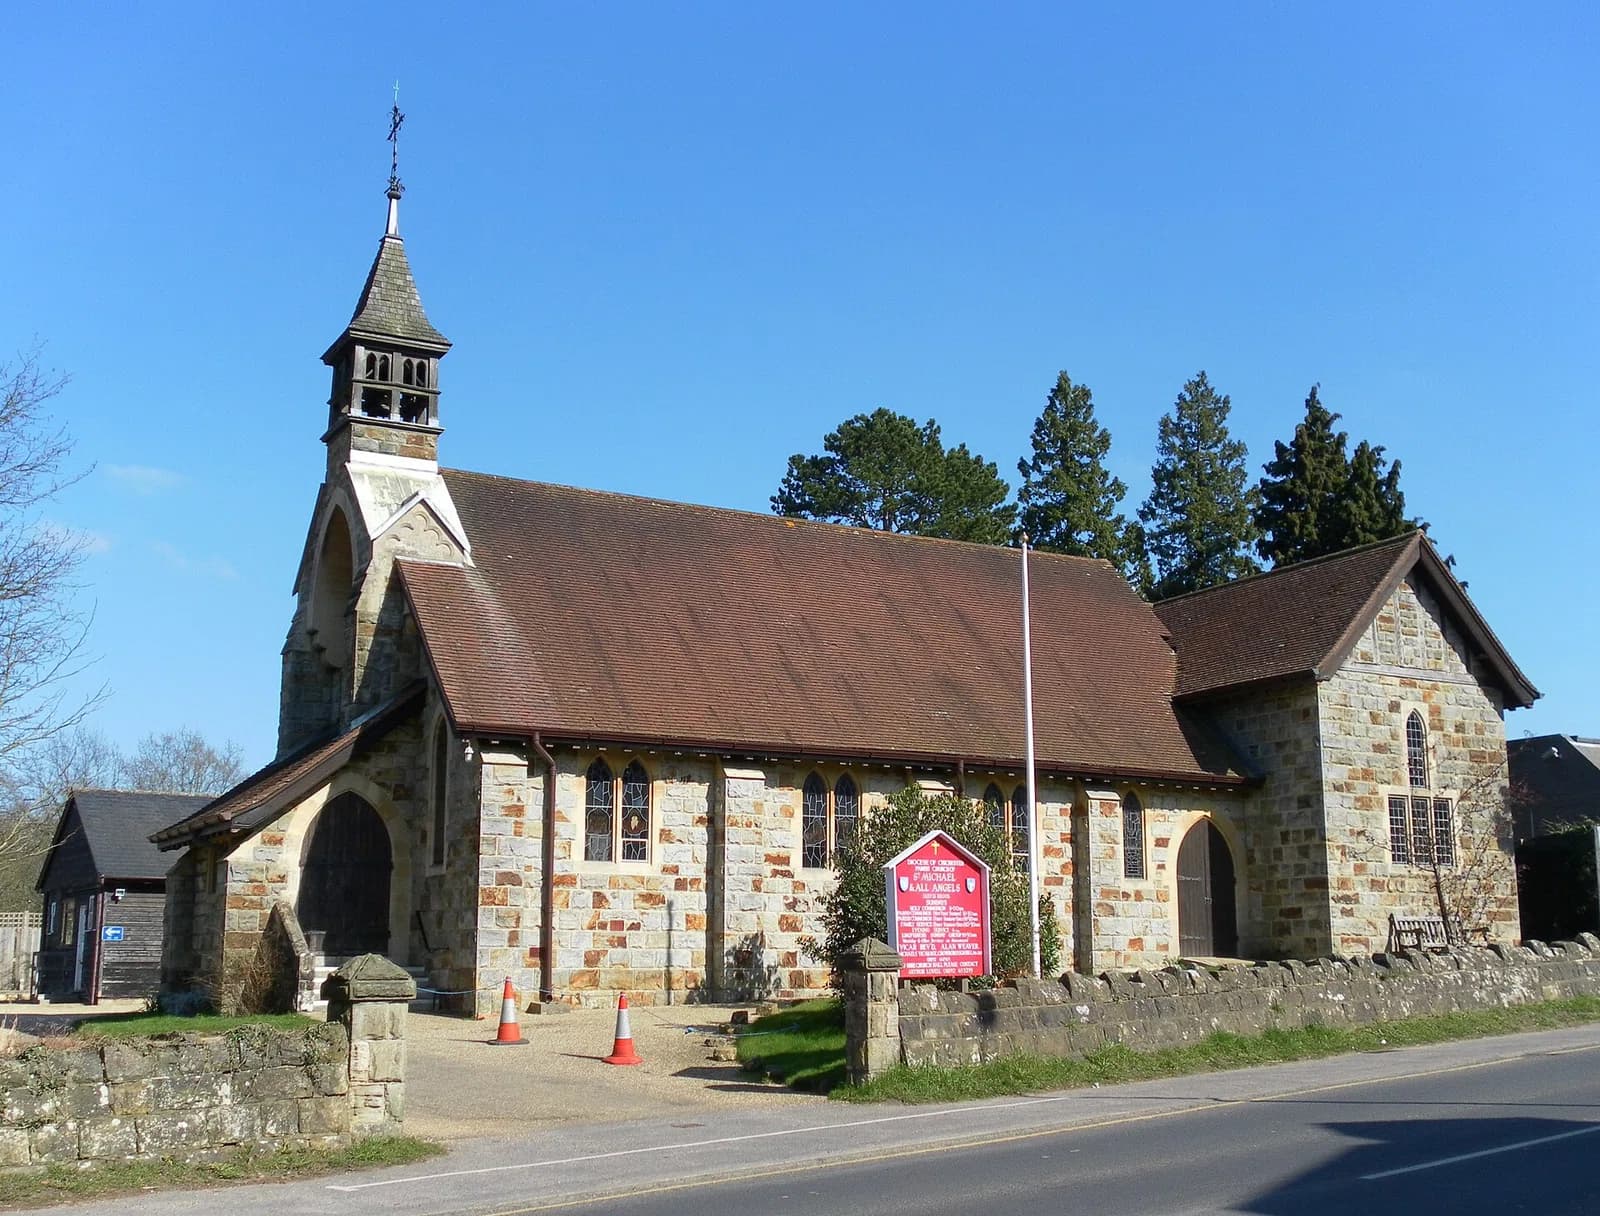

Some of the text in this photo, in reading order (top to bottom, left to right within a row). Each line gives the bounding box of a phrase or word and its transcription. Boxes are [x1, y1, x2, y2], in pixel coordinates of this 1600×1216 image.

[921, 873, 956, 881] MICHAEL
[916, 883, 929, 892] ALL
[932, 884, 961, 892] ANGELS
